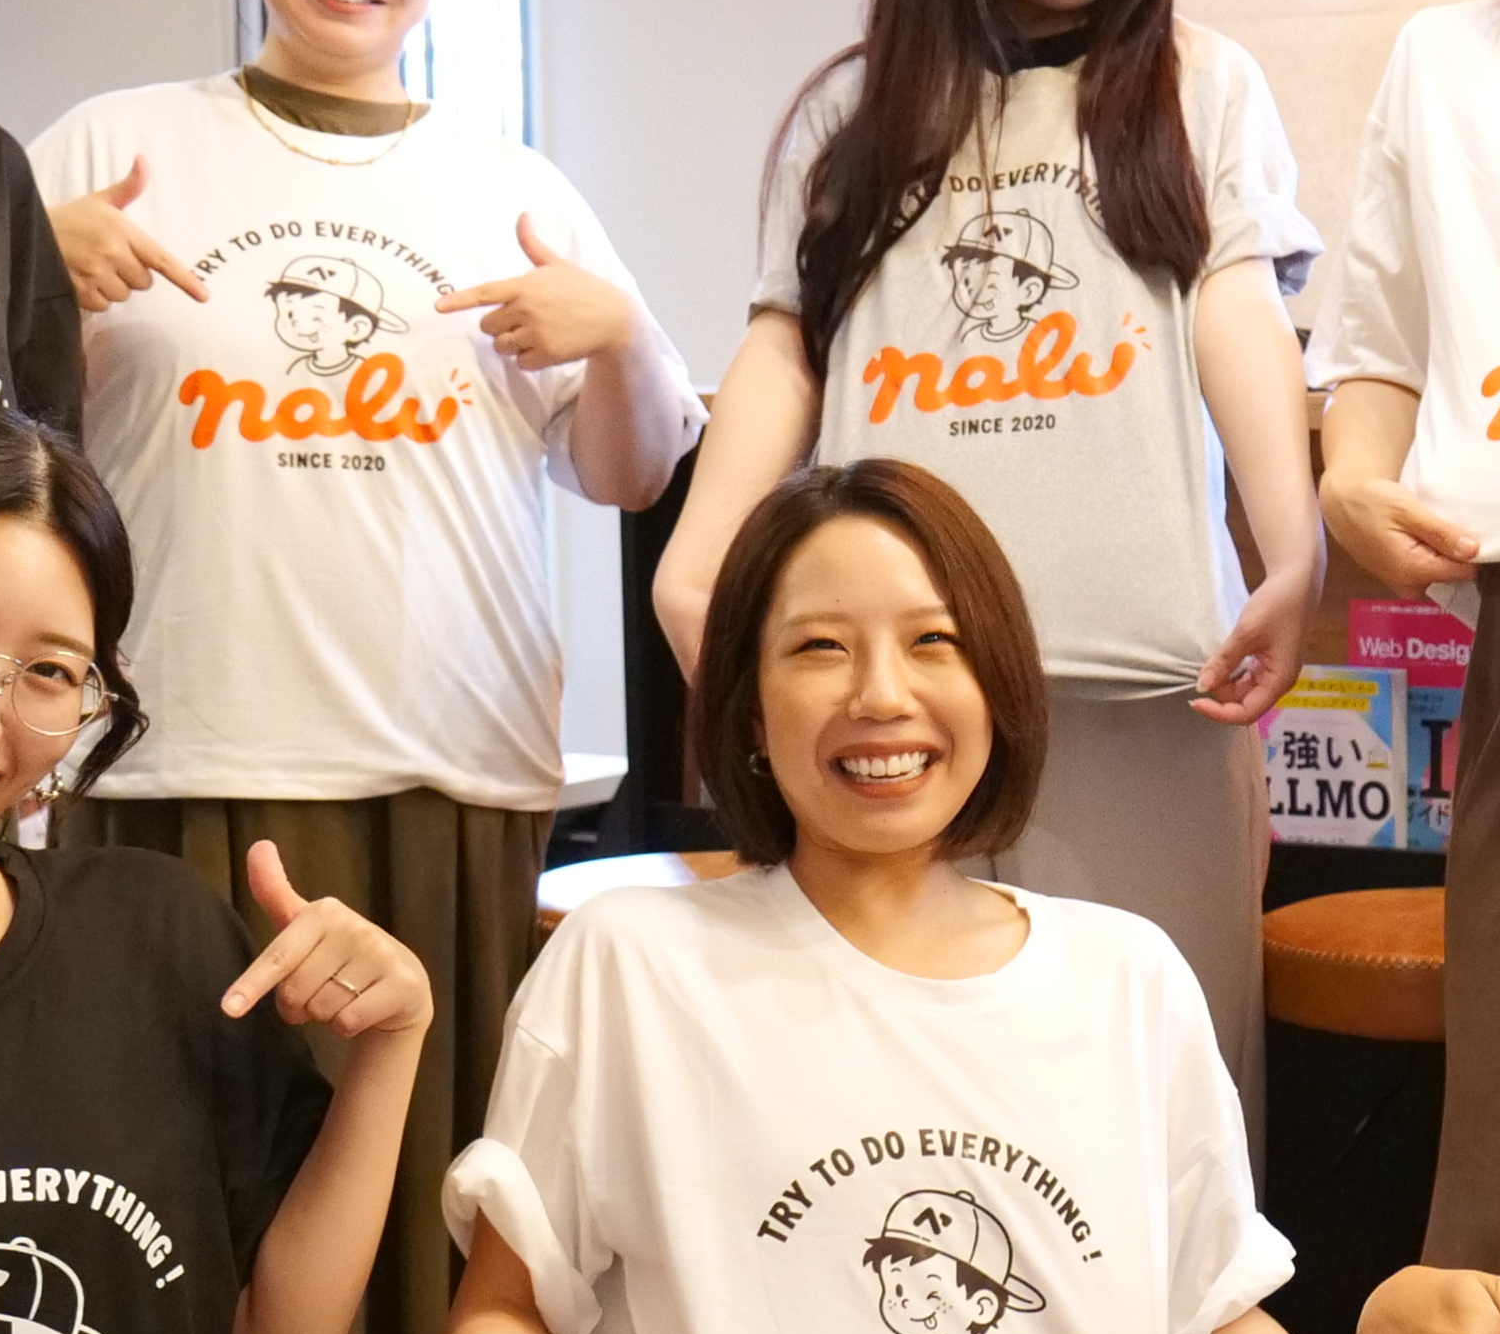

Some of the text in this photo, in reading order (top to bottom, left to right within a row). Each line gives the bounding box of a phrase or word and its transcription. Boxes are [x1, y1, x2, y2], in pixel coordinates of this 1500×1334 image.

[949, 175, 981, 193] DO
[229, 230, 262, 252] TO
[269, 220, 302, 240] DO
[862, 310, 1136, 424] nalu
[178, 352, 459, 449] nalu
[949, 414, 1057, 437] SINCE 2020
[277, 452, 385, 471] SINCE 2020
[1359, 636, 1404, 659] Web
[1283, 730, 1362, 770] 強い
[756, 1179, 814, 1244] TRY
[809, 1147, 856, 1189] TO
[860, 1130, 906, 1167] DO
